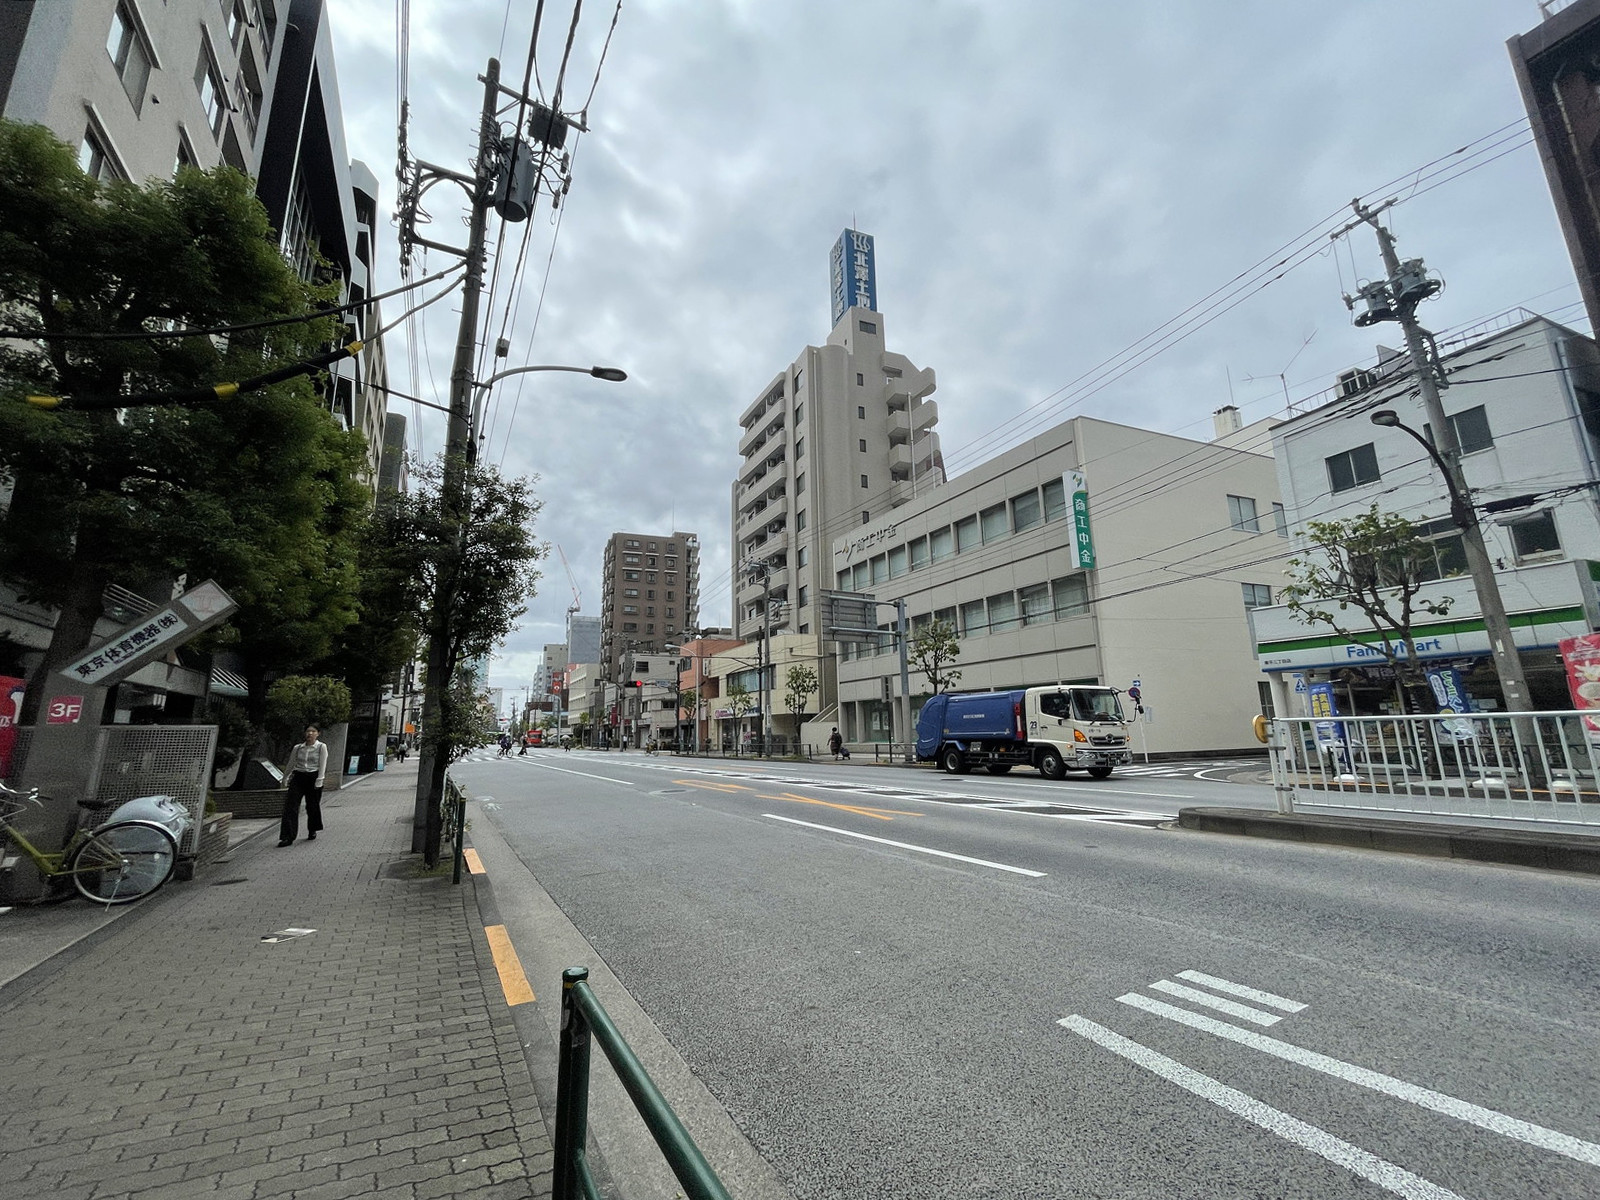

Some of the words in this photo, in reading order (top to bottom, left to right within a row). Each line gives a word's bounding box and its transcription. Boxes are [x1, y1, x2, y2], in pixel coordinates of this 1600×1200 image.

[1074, 498, 1092, 563] 商工中金
[74, 612, 179, 679] 東京体育機器(株)
[1346, 638, 1442, 659] Famiyart
[50, 703, 81, 718] 3F
[1029, 720, 1037, 729] 23
